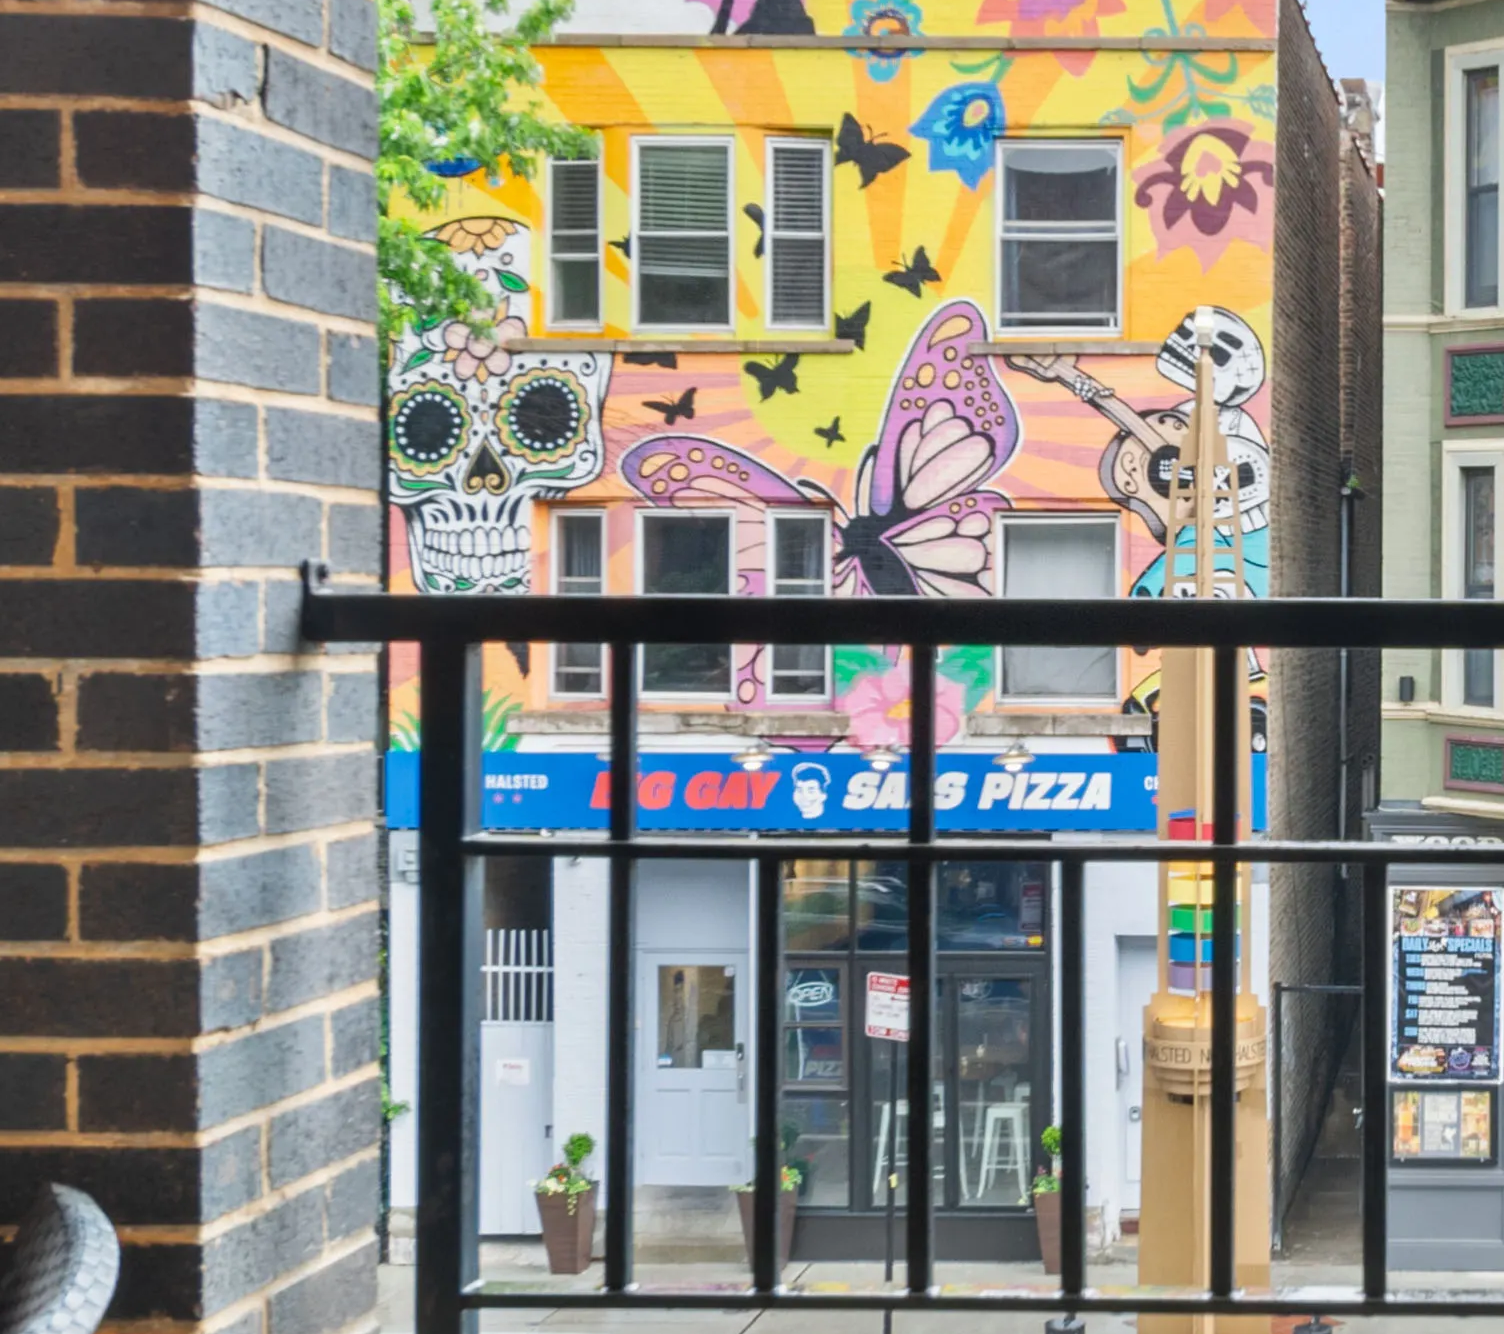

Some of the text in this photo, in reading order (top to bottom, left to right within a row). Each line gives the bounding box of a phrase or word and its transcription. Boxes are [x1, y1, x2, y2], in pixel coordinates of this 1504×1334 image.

[484, 774, 548, 790] HALSTED
[590, 771, 782, 810] BG GAY
[842, 772, 970, 810] SAS
[977, 772, 1113, 811] PIZZA
[1447, 937, 1493, 952] SPECIALS
[789, 986, 833, 1002] OPEN
[1148, 1046, 1192, 1064] ALSTED
